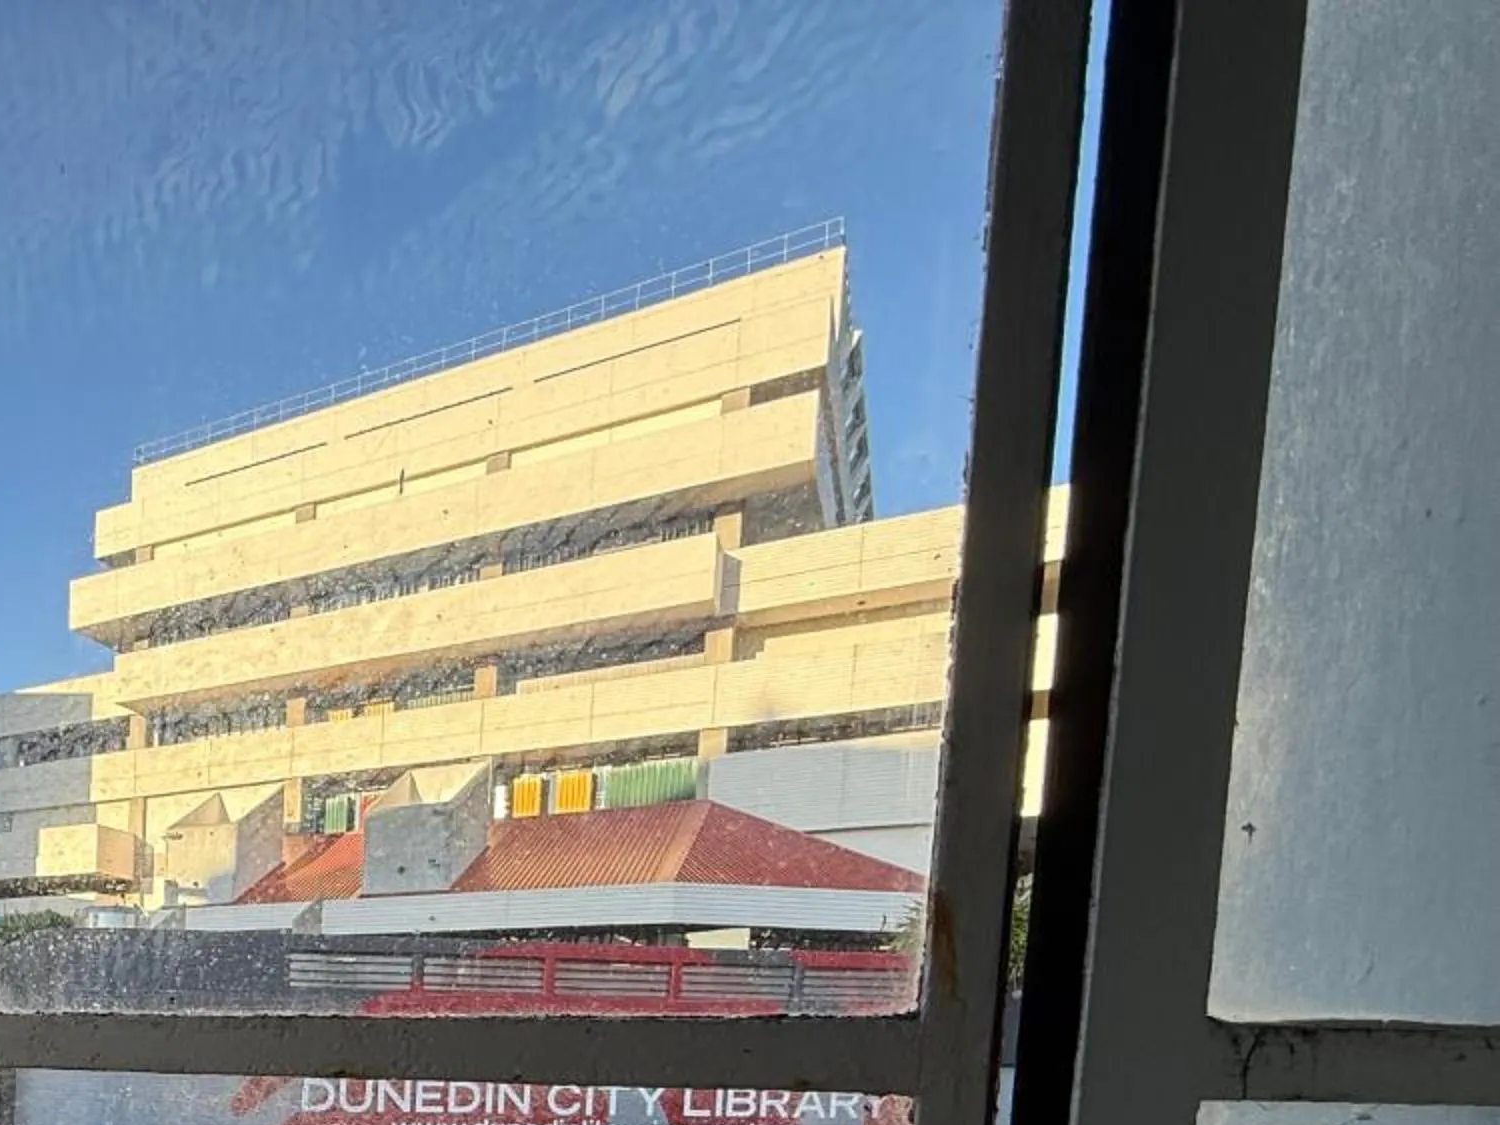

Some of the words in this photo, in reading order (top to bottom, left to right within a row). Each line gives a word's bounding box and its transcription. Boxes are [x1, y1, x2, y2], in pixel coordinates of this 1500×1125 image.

[301, 1078, 531, 1114] DUNEDIN
[547, 1085, 663, 1117] CITY
[682, 1089, 884, 1119] LIBRARY
